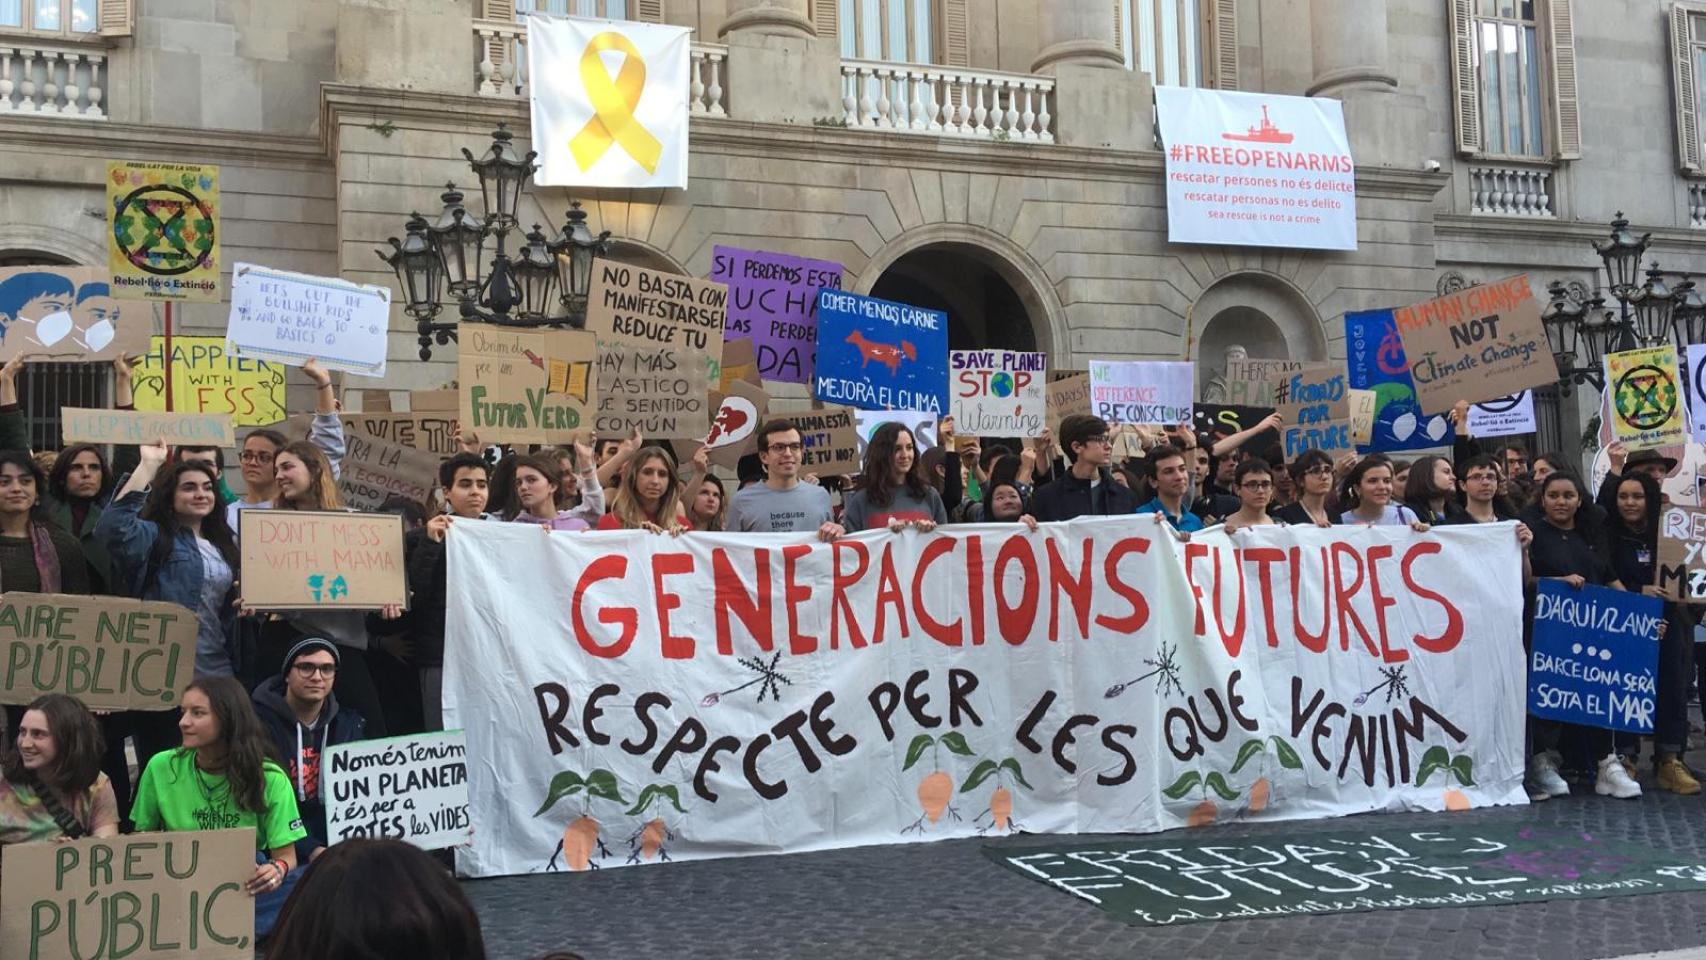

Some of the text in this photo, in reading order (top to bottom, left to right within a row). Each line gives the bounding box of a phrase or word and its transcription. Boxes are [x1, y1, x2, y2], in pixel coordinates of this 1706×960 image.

[1170, 143, 1352, 173] #FREEOPENARMS
[1170, 171, 1353, 193] rescatar persones no és delicte
[1184, 190, 1229, 203] rescatar
[1232, 194, 1279, 208] personas
[1282, 196, 1296, 207] no
[1311, 197, 1341, 209] delito
[1208, 210, 1224, 219] sea
[1226, 211, 1257, 221] rescue
[1260, 211, 1267, 221] is
[1270, 213, 1285, 222] not
[1295, 214, 1321, 224] crime
[163, 280, 170, 288] o
[173, 280, 215, 290] Extinció
[602, 266, 727, 308] NO BASTA CON
[714, 256, 842, 290] SI PERDEMOS ESTA
[821, 292, 939, 330] COMER MENOS CARNE
[1395, 274, 1535, 334] HUMAN CHANGE
[612, 315, 707, 349] REDUCE TU
[724, 317, 752, 333] LAS
[1450, 314, 1500, 349] NOT
[634, 349, 677, 374] MÁS
[952, 352, 1047, 371] SAVE PLANET
[1412, 351, 1477, 385] Climate
[1481, 337, 1537, 365] Change
[189, 375, 232, 385] WITH
[959, 370, 1032, 398] STOP
[1094, 386, 1158, 403] DIFFERENCE
[471, 385, 580, 429] FUTUR VERD
[626, 397, 700, 413] SENTIDO
[879, 387, 896, 408] EL
[898, 390, 941, 415] CLIMA
[1298, 403, 1330, 425] FOR
[596, 415, 676, 432] COMÚN
[955, 400, 1041, 437] Warming
[815, 450, 831, 464] TU
[836, 448, 855, 462] NO?
[1285, 425, 1349, 457] FUTURE
[770, 511, 805, 521] because
[771, 520, 794, 529] there
[259, 519, 382, 546] DON'T MESS
[264, 548, 397, 570] WITH MAMA
[571, 535, 1464, 664] GENERACIONS FUTURES
[0, 603, 178, 645] AIRE NET
[1620, 612, 1661, 641] ANYS
[5, 640, 181, 702] PÚBLIC!
[1532, 651, 1656, 695] BARCELONA SERÀ
[1537, 683, 1656, 730] SOTA EL MAR
[533, 668, 1468, 803] RESPECTE PER LES QUE VENIM
[331, 744, 407, 774] Només
[406, 741, 466, 763] tenim
[333, 762, 467, 802] UN PLANETA
[330, 798, 416, 825] i és per a
[410, 814, 431, 837] les
[430, 803, 470, 833] VIDES
[55, 839, 200, 891] PREU
[1006, 831, 1508, 879] FRIDAYS
[29, 883, 249, 960] PÚBLIC,
